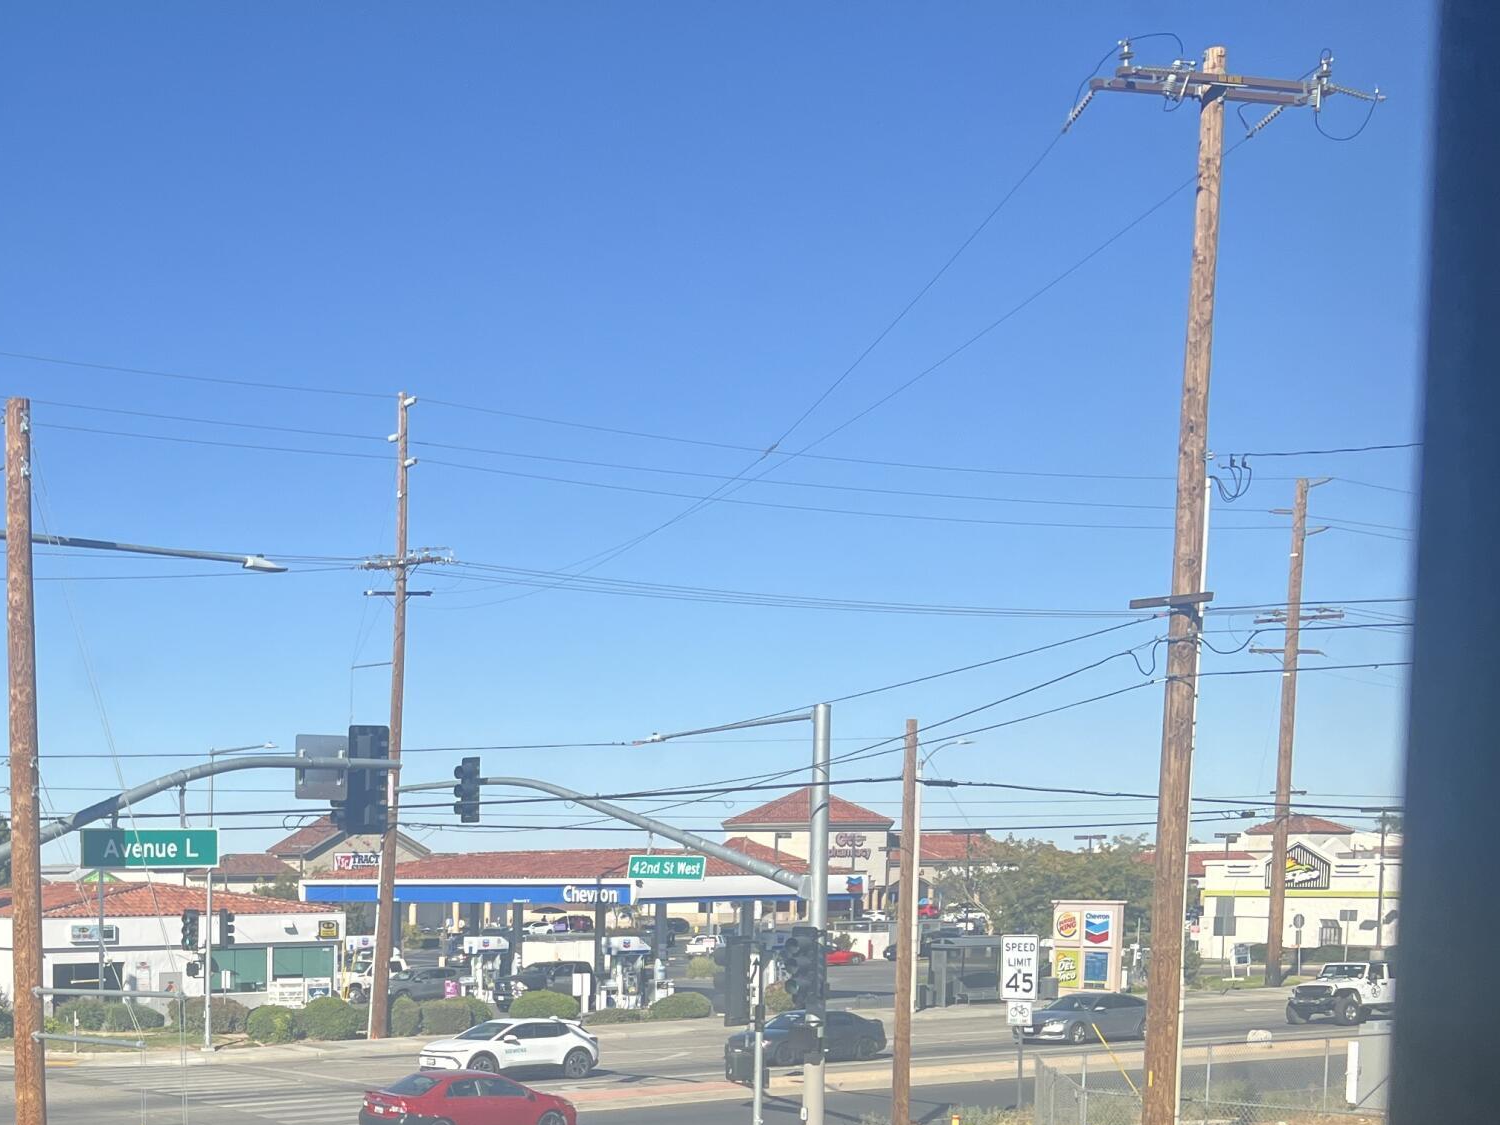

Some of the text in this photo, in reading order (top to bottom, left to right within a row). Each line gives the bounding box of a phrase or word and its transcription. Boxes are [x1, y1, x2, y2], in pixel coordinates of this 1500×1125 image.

[103, 838, 199, 858] Avenue L
[352, 855, 380, 864] TRACT
[632, 862, 700, 875] 42nd St West
[563, 885, 618, 903] Chevron
[1085, 912, 1110, 920] Chevron
[1060, 922, 1077, 932] KING
[1005, 942, 1036, 952] SPEED
[1008, 958, 1032, 967] LIMIT
[1058, 960, 1076, 971] DEL
[1005, 972, 1034, 993] 45
